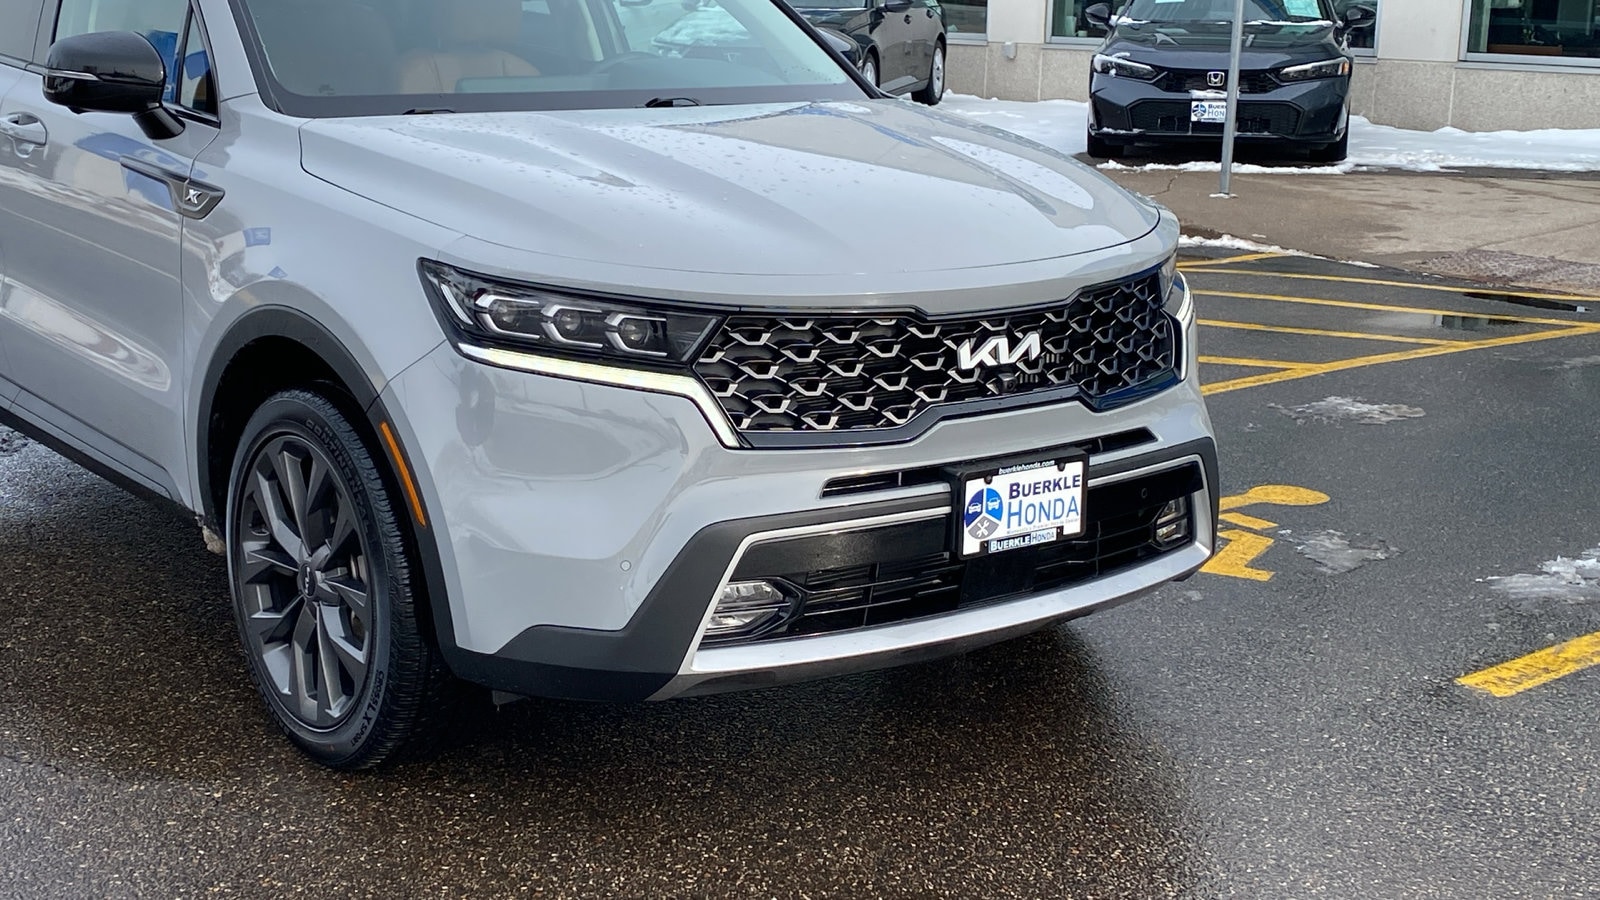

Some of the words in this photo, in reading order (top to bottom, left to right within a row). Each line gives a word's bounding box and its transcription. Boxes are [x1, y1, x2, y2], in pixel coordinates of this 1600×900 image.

[957, 331, 1041, 370] KIA
[305, 419, 369, 534] CONTINENTAL
[999, 460, 1055, 475] buerklehonda.com
[1008, 474, 1081, 499] BUERKLE
[1007, 495, 1079, 529] HONDA
[991, 535, 1031, 551] BUERKLE
[1031, 532, 1055, 544] HONDA
[350, 722, 368, 747] SPORT
